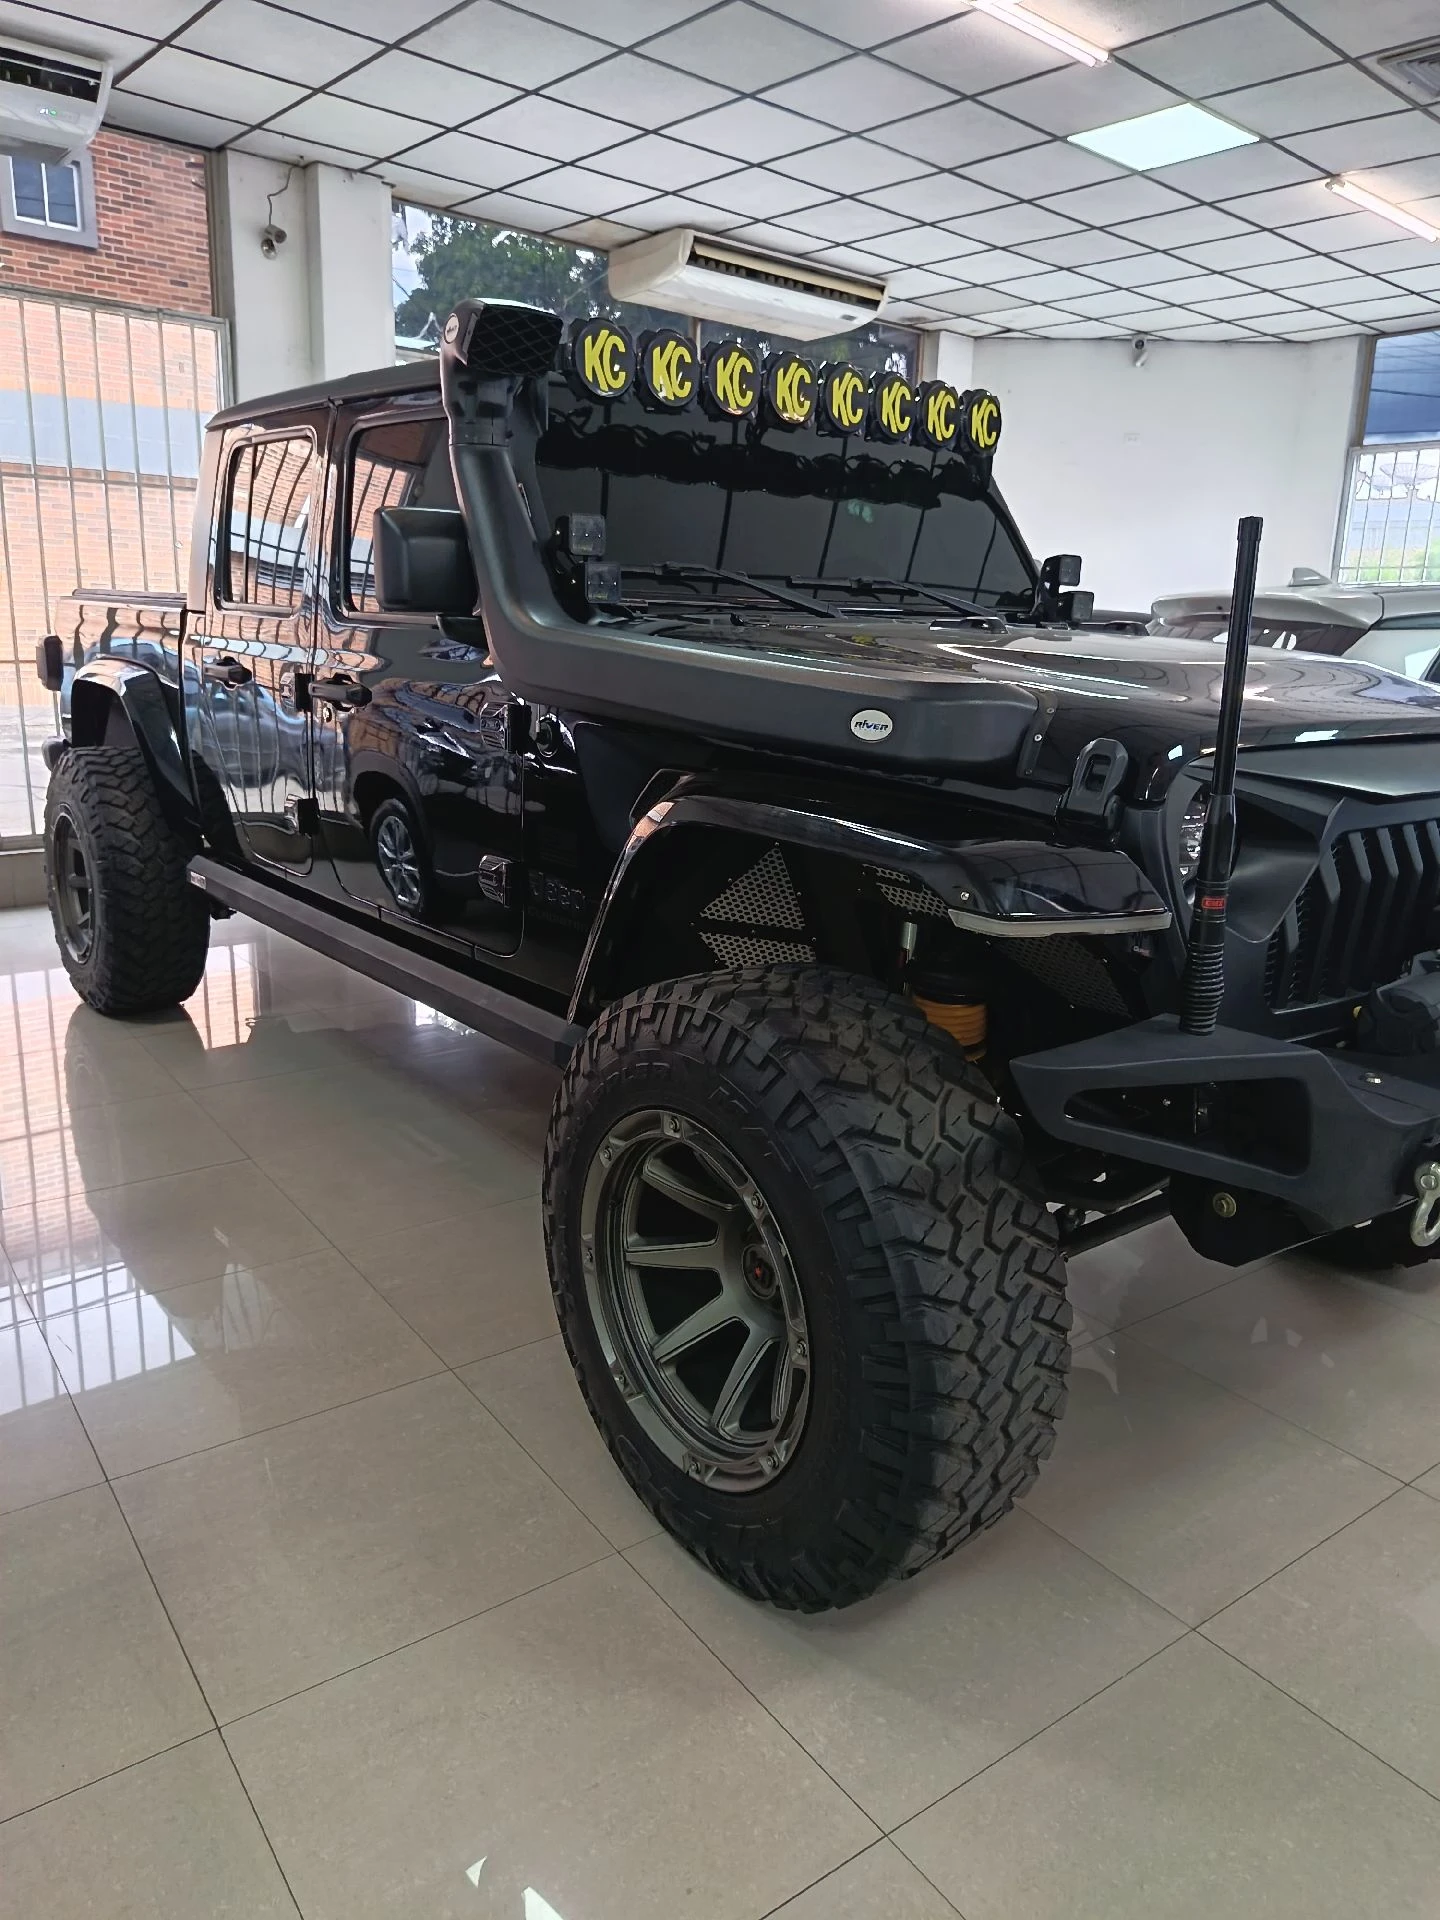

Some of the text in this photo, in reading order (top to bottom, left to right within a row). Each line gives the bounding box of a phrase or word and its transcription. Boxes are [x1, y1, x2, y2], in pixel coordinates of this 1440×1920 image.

[585, 329, 626, 392] KC
[653, 341, 691, 400] KC
[717, 352, 753, 409] KC
[777, 362, 811, 418] KC
[833, 372, 863, 426] KC
[882, 380, 911, 433] KC
[928, 390, 956, 441] KC
[971, 399, 997, 448] KC
